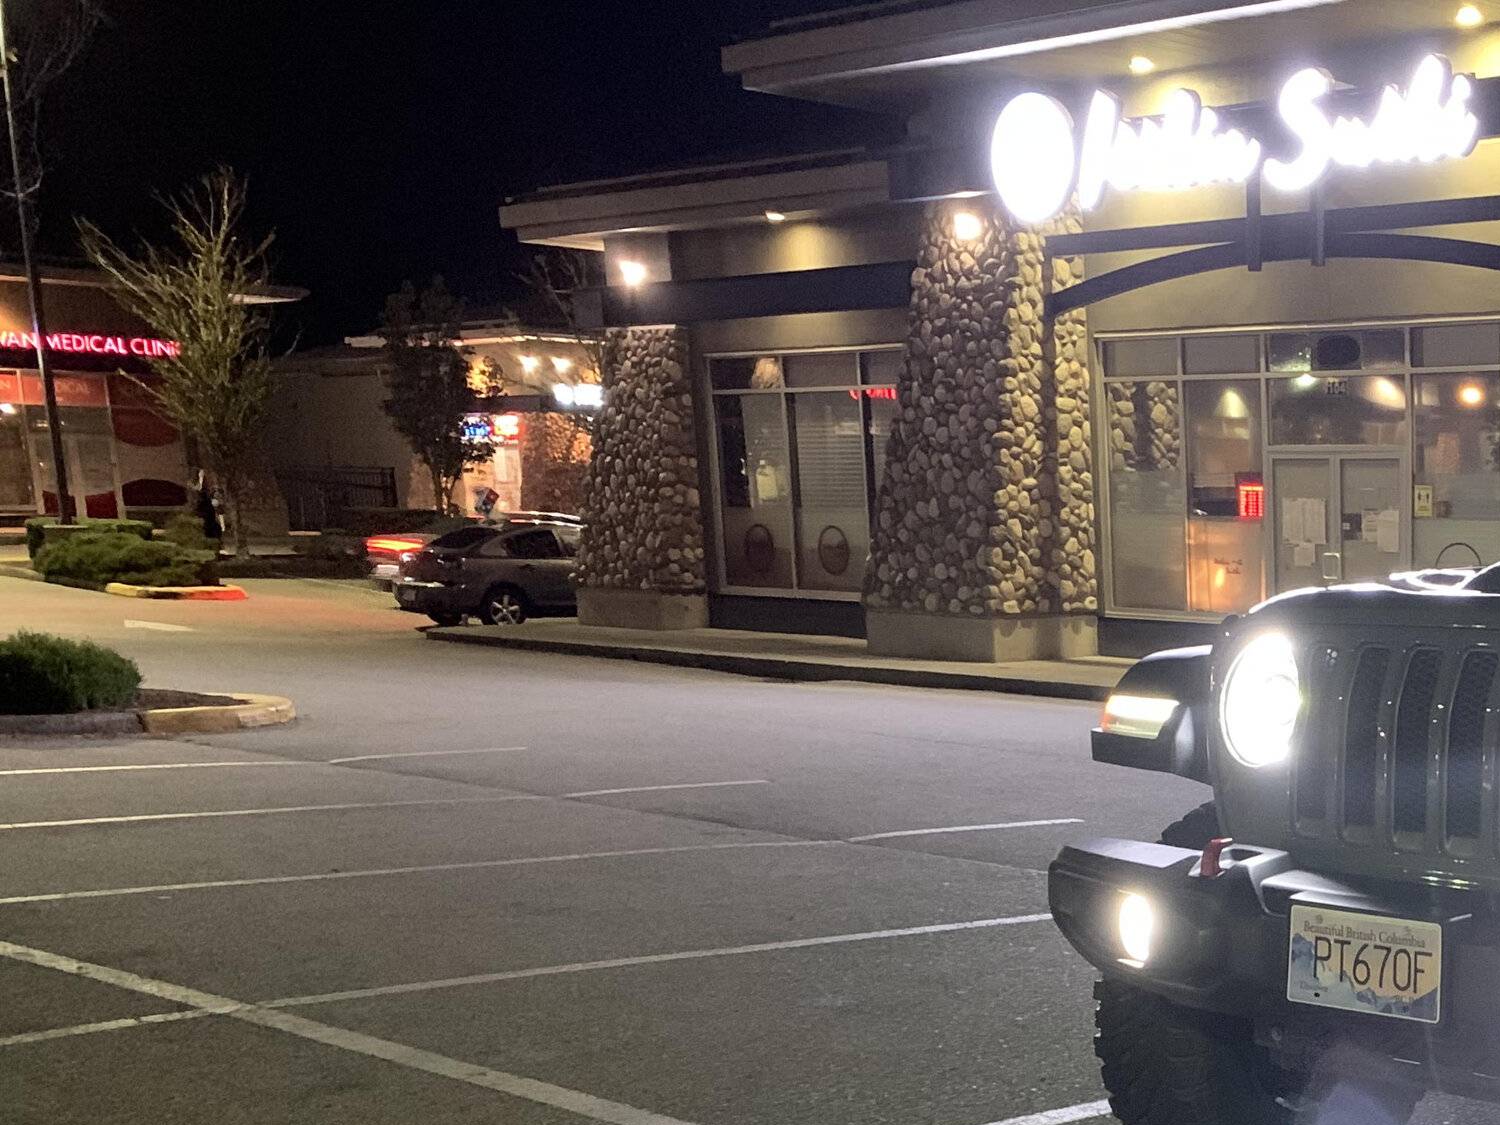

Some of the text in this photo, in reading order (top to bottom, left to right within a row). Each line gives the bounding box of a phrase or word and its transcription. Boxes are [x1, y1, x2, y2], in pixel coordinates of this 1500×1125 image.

[45, 333, 128, 356] MEDICAL
[1303, 920, 1425, 948] Beautiful British Columbia
[1313, 936, 1433, 994] PT670F
